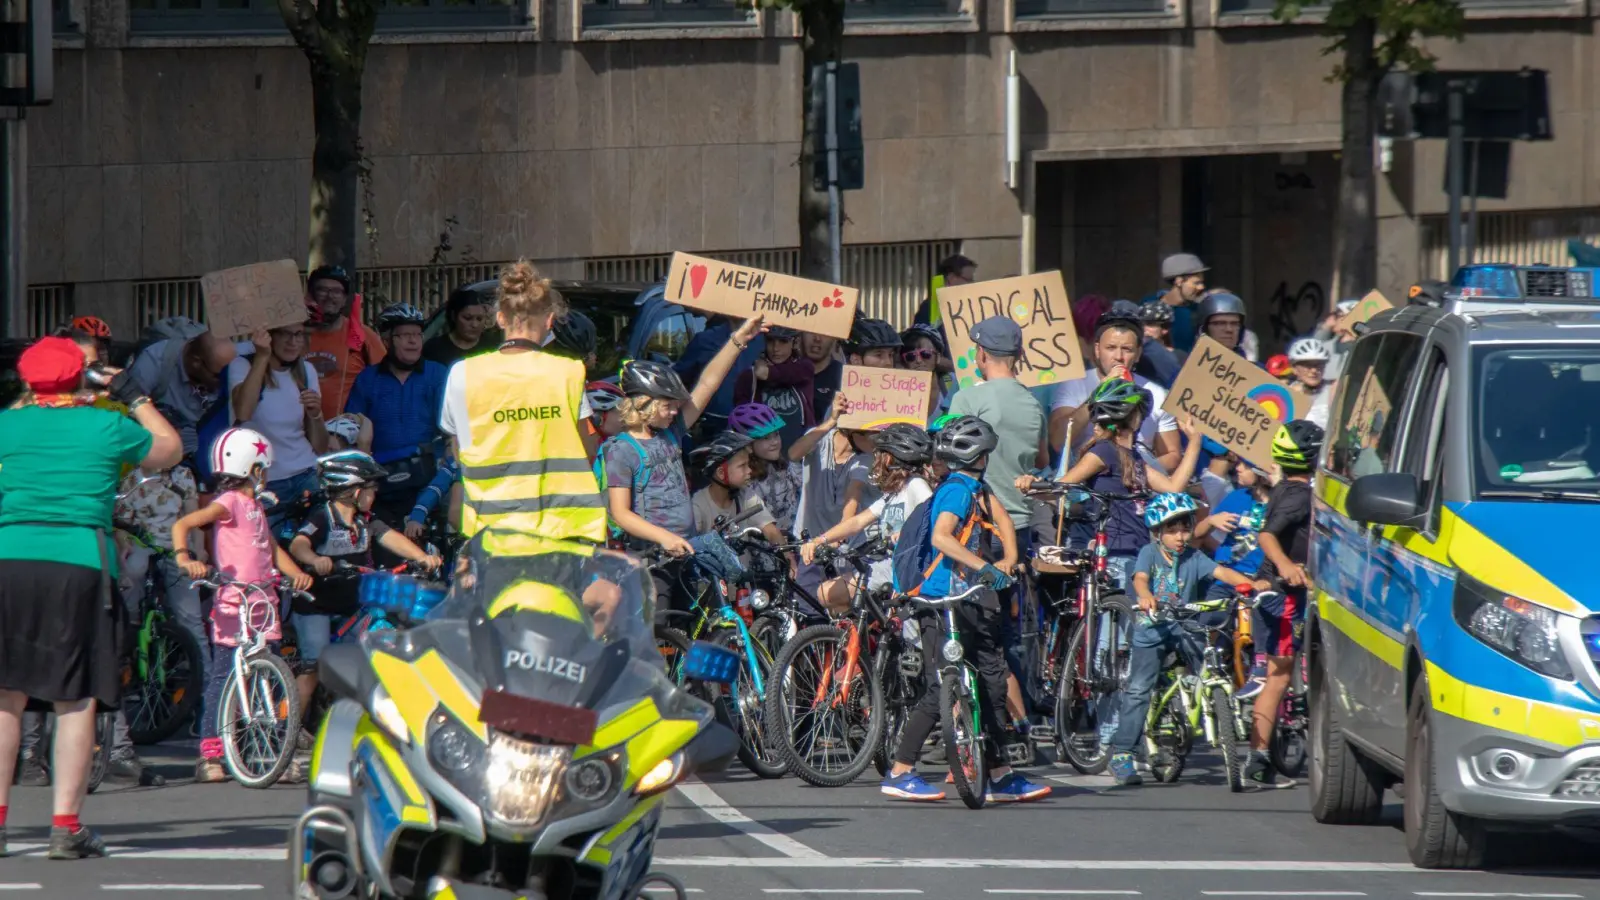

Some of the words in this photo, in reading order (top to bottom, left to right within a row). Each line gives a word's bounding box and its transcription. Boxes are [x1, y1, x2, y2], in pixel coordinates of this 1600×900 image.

[752, 292, 819, 318] FAHRRAD
[1011, 332, 1071, 376] ASS
[1197, 347, 1247, 389] Mehr
[847, 370, 871, 388] Die
[879, 373, 926, 397] Straße
[493, 405, 561, 423] ORDNER
[846, 395, 888, 415] gehört
[1176, 387, 1260, 452] Radwege!
[504, 649, 586, 683] POLIZEI
